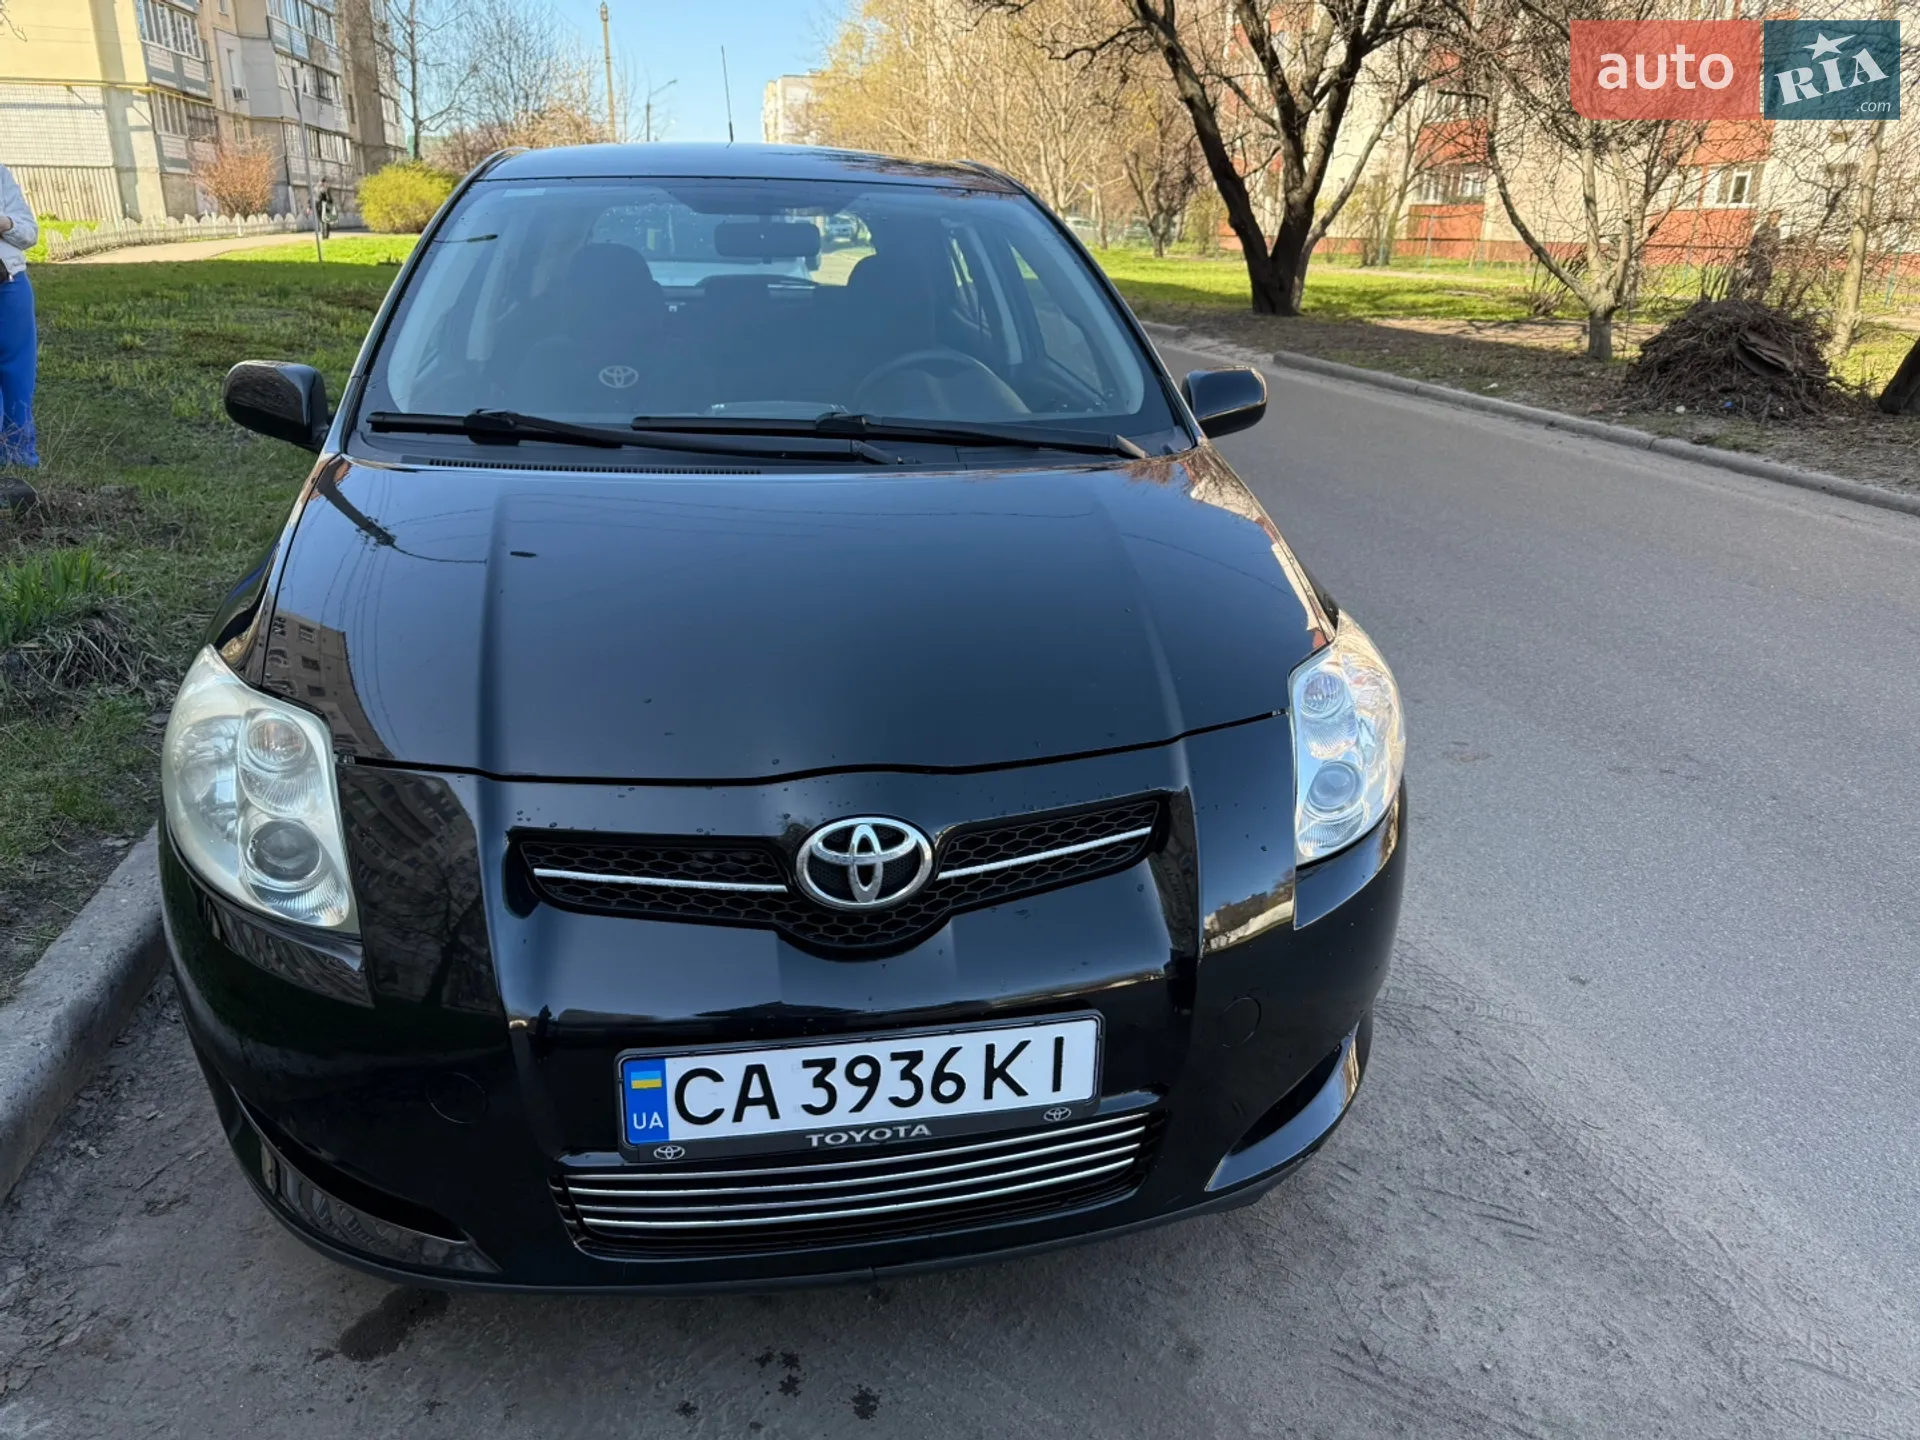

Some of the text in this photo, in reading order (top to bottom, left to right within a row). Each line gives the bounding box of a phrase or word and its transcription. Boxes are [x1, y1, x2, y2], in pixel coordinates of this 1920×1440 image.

[674, 1036, 1063, 1125] CA 3936 KI
[632, 1112, 664, 1131] UA
[806, 1124, 932, 1147] TOYOTA
